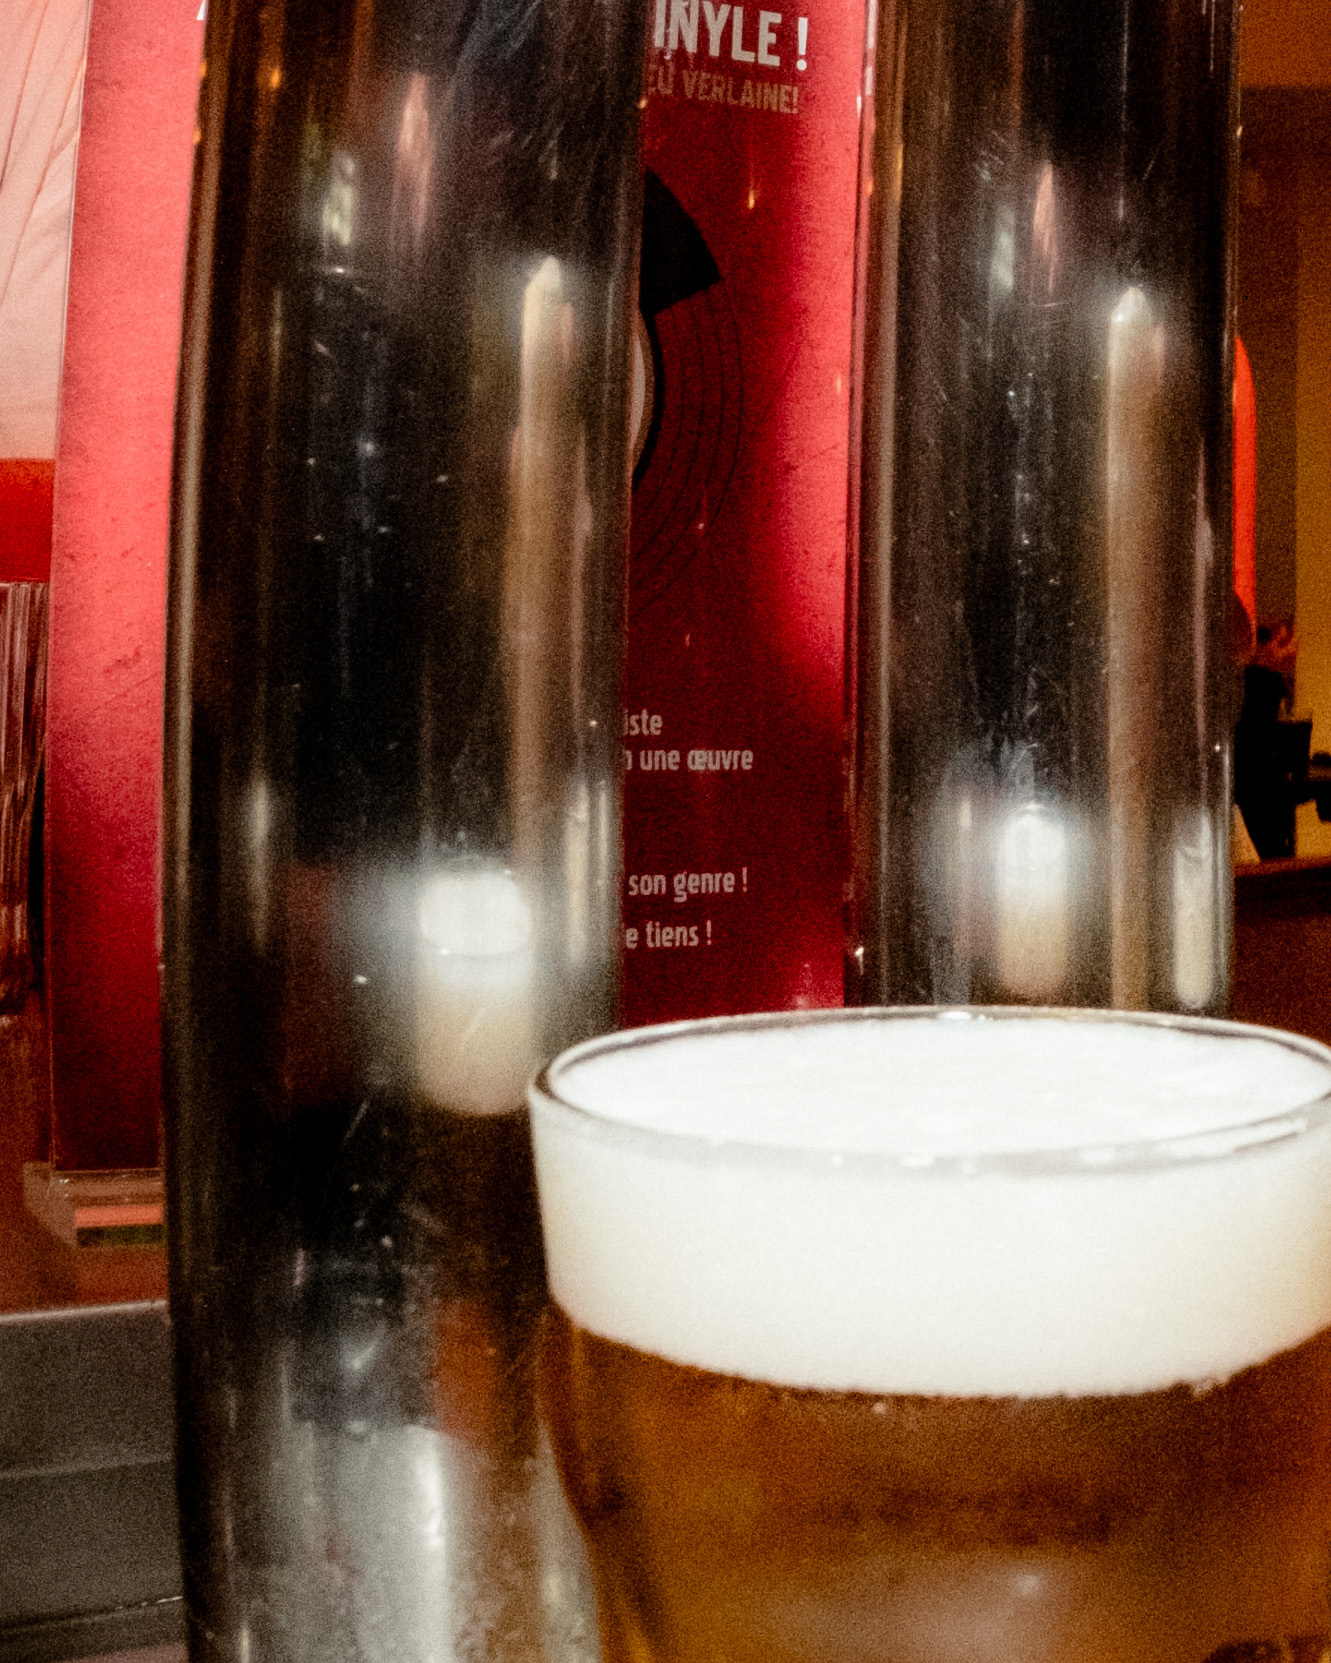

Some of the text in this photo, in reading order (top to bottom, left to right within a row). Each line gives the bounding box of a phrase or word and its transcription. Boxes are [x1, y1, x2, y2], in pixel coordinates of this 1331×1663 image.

[640, 749, 680, 771] une
[687, 748, 754, 771] œuvre
[628, 874, 667, 896] son
[673, 870, 736, 903] genre
[646, 920, 699, 948] tiens
